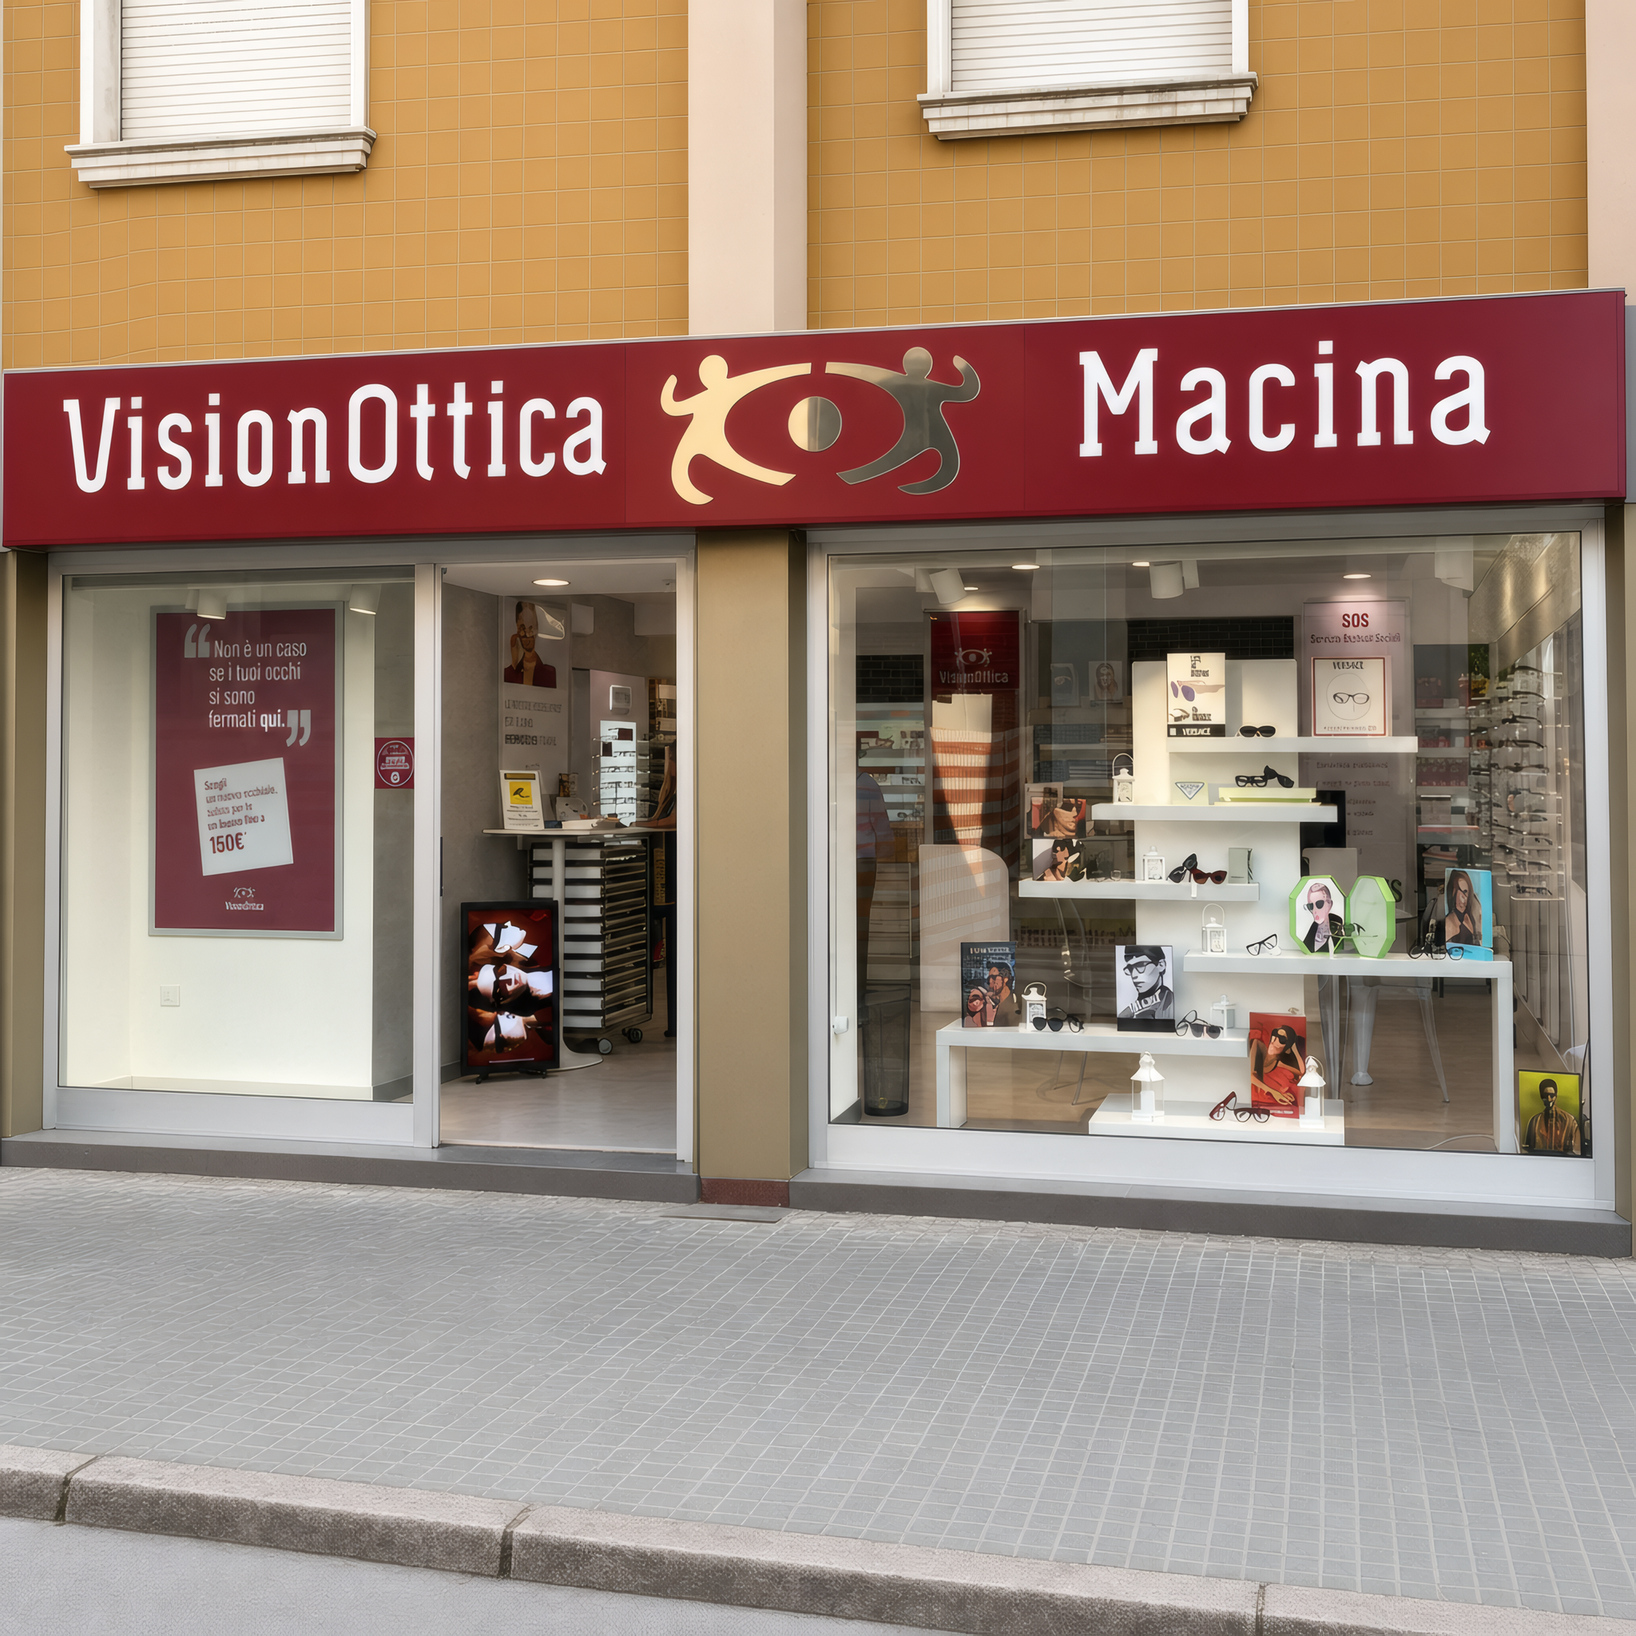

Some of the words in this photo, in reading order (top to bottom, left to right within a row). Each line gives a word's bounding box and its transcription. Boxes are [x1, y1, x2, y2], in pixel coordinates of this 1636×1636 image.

[1079, 340, 1491, 457] Macina
[62, 380, 607, 494] VisionOttica
[1341, 612, 1369, 628] SOS
[214, 640, 240, 658] Non
[243, 639, 252, 658] è
[256, 643, 272, 657] un
[276, 642, 307, 657] caso
[209, 667, 225, 682] se
[228, 661, 232, 681] i
[236, 662, 261, 681] tuoi
[265, 661, 301, 680] occhi
[208, 687, 220, 705] si
[224, 690, 255, 705] sono
[208, 709, 256, 728] fermati
[260, 708, 285, 732] qui.
